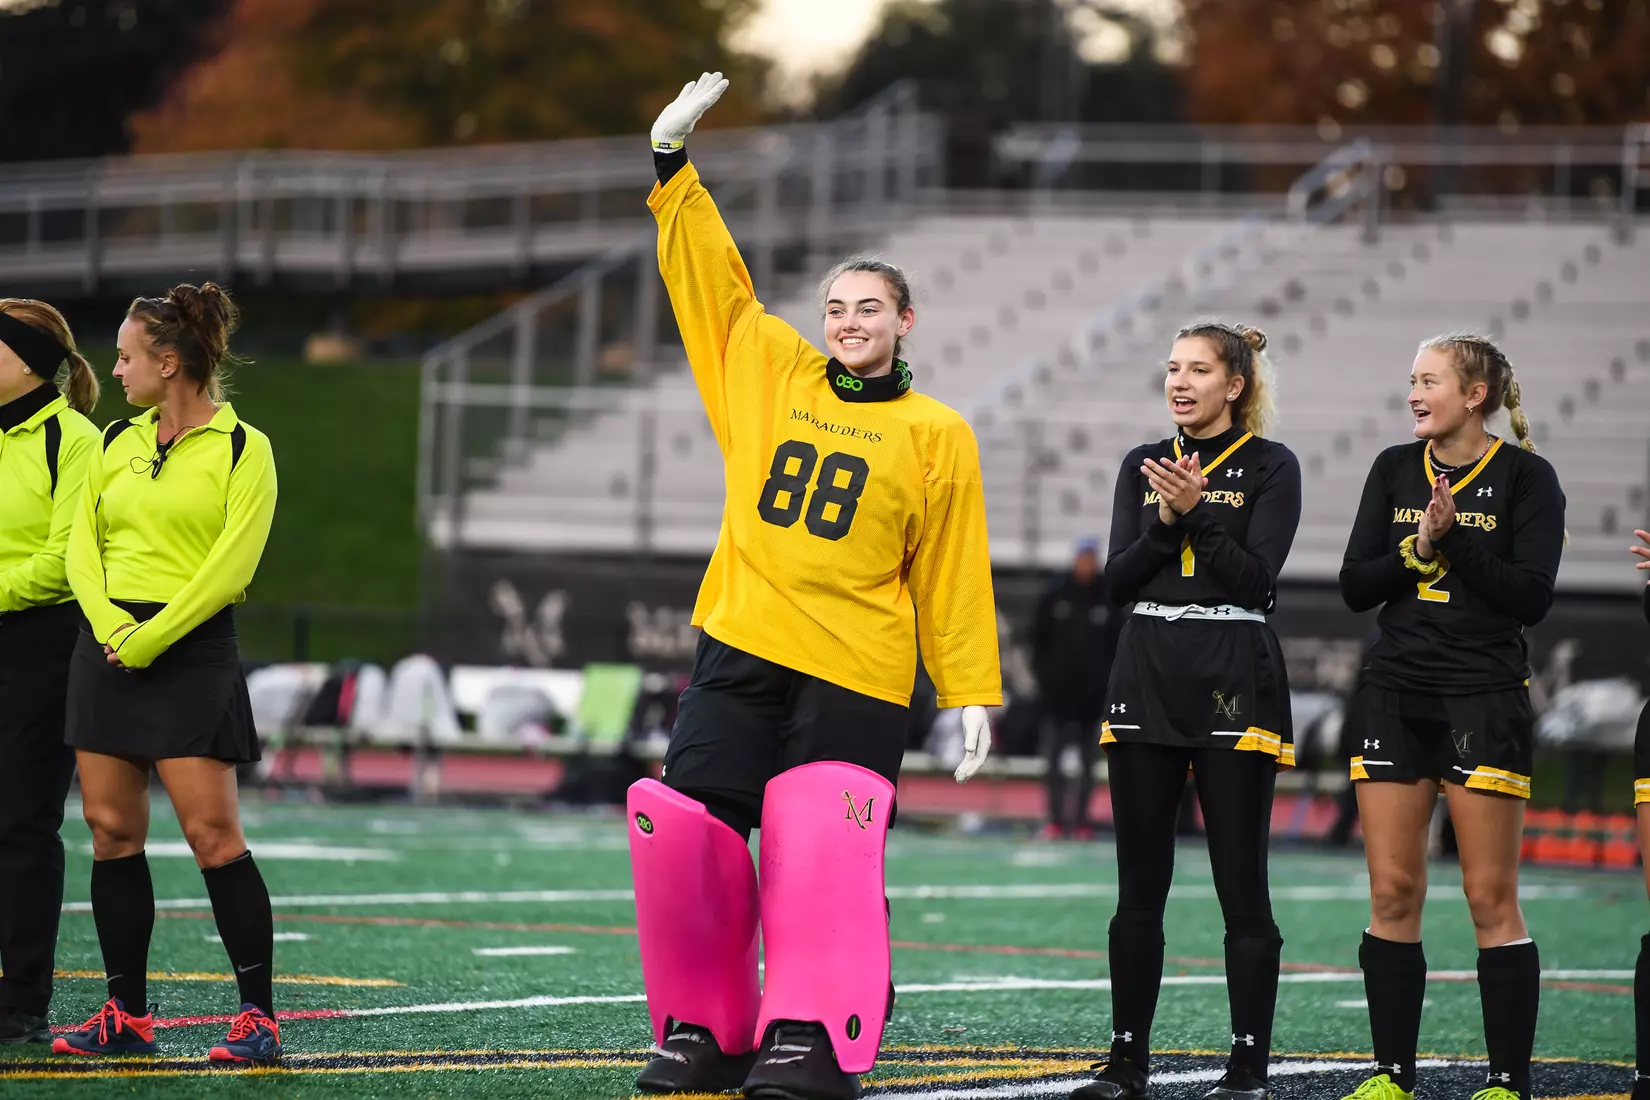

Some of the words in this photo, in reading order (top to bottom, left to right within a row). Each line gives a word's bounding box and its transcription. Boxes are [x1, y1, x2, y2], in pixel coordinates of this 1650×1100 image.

[836, 374, 863, 392] OBO
[790, 408, 883, 444] MARAUDERS
[757, 439, 870, 542] 88
[1142, 490, 1245, 508] MADERS
[1392, 507, 1497, 532] MARERS
[1416, 550, 1451, 603] 2
[841, 789, 879, 831] M
